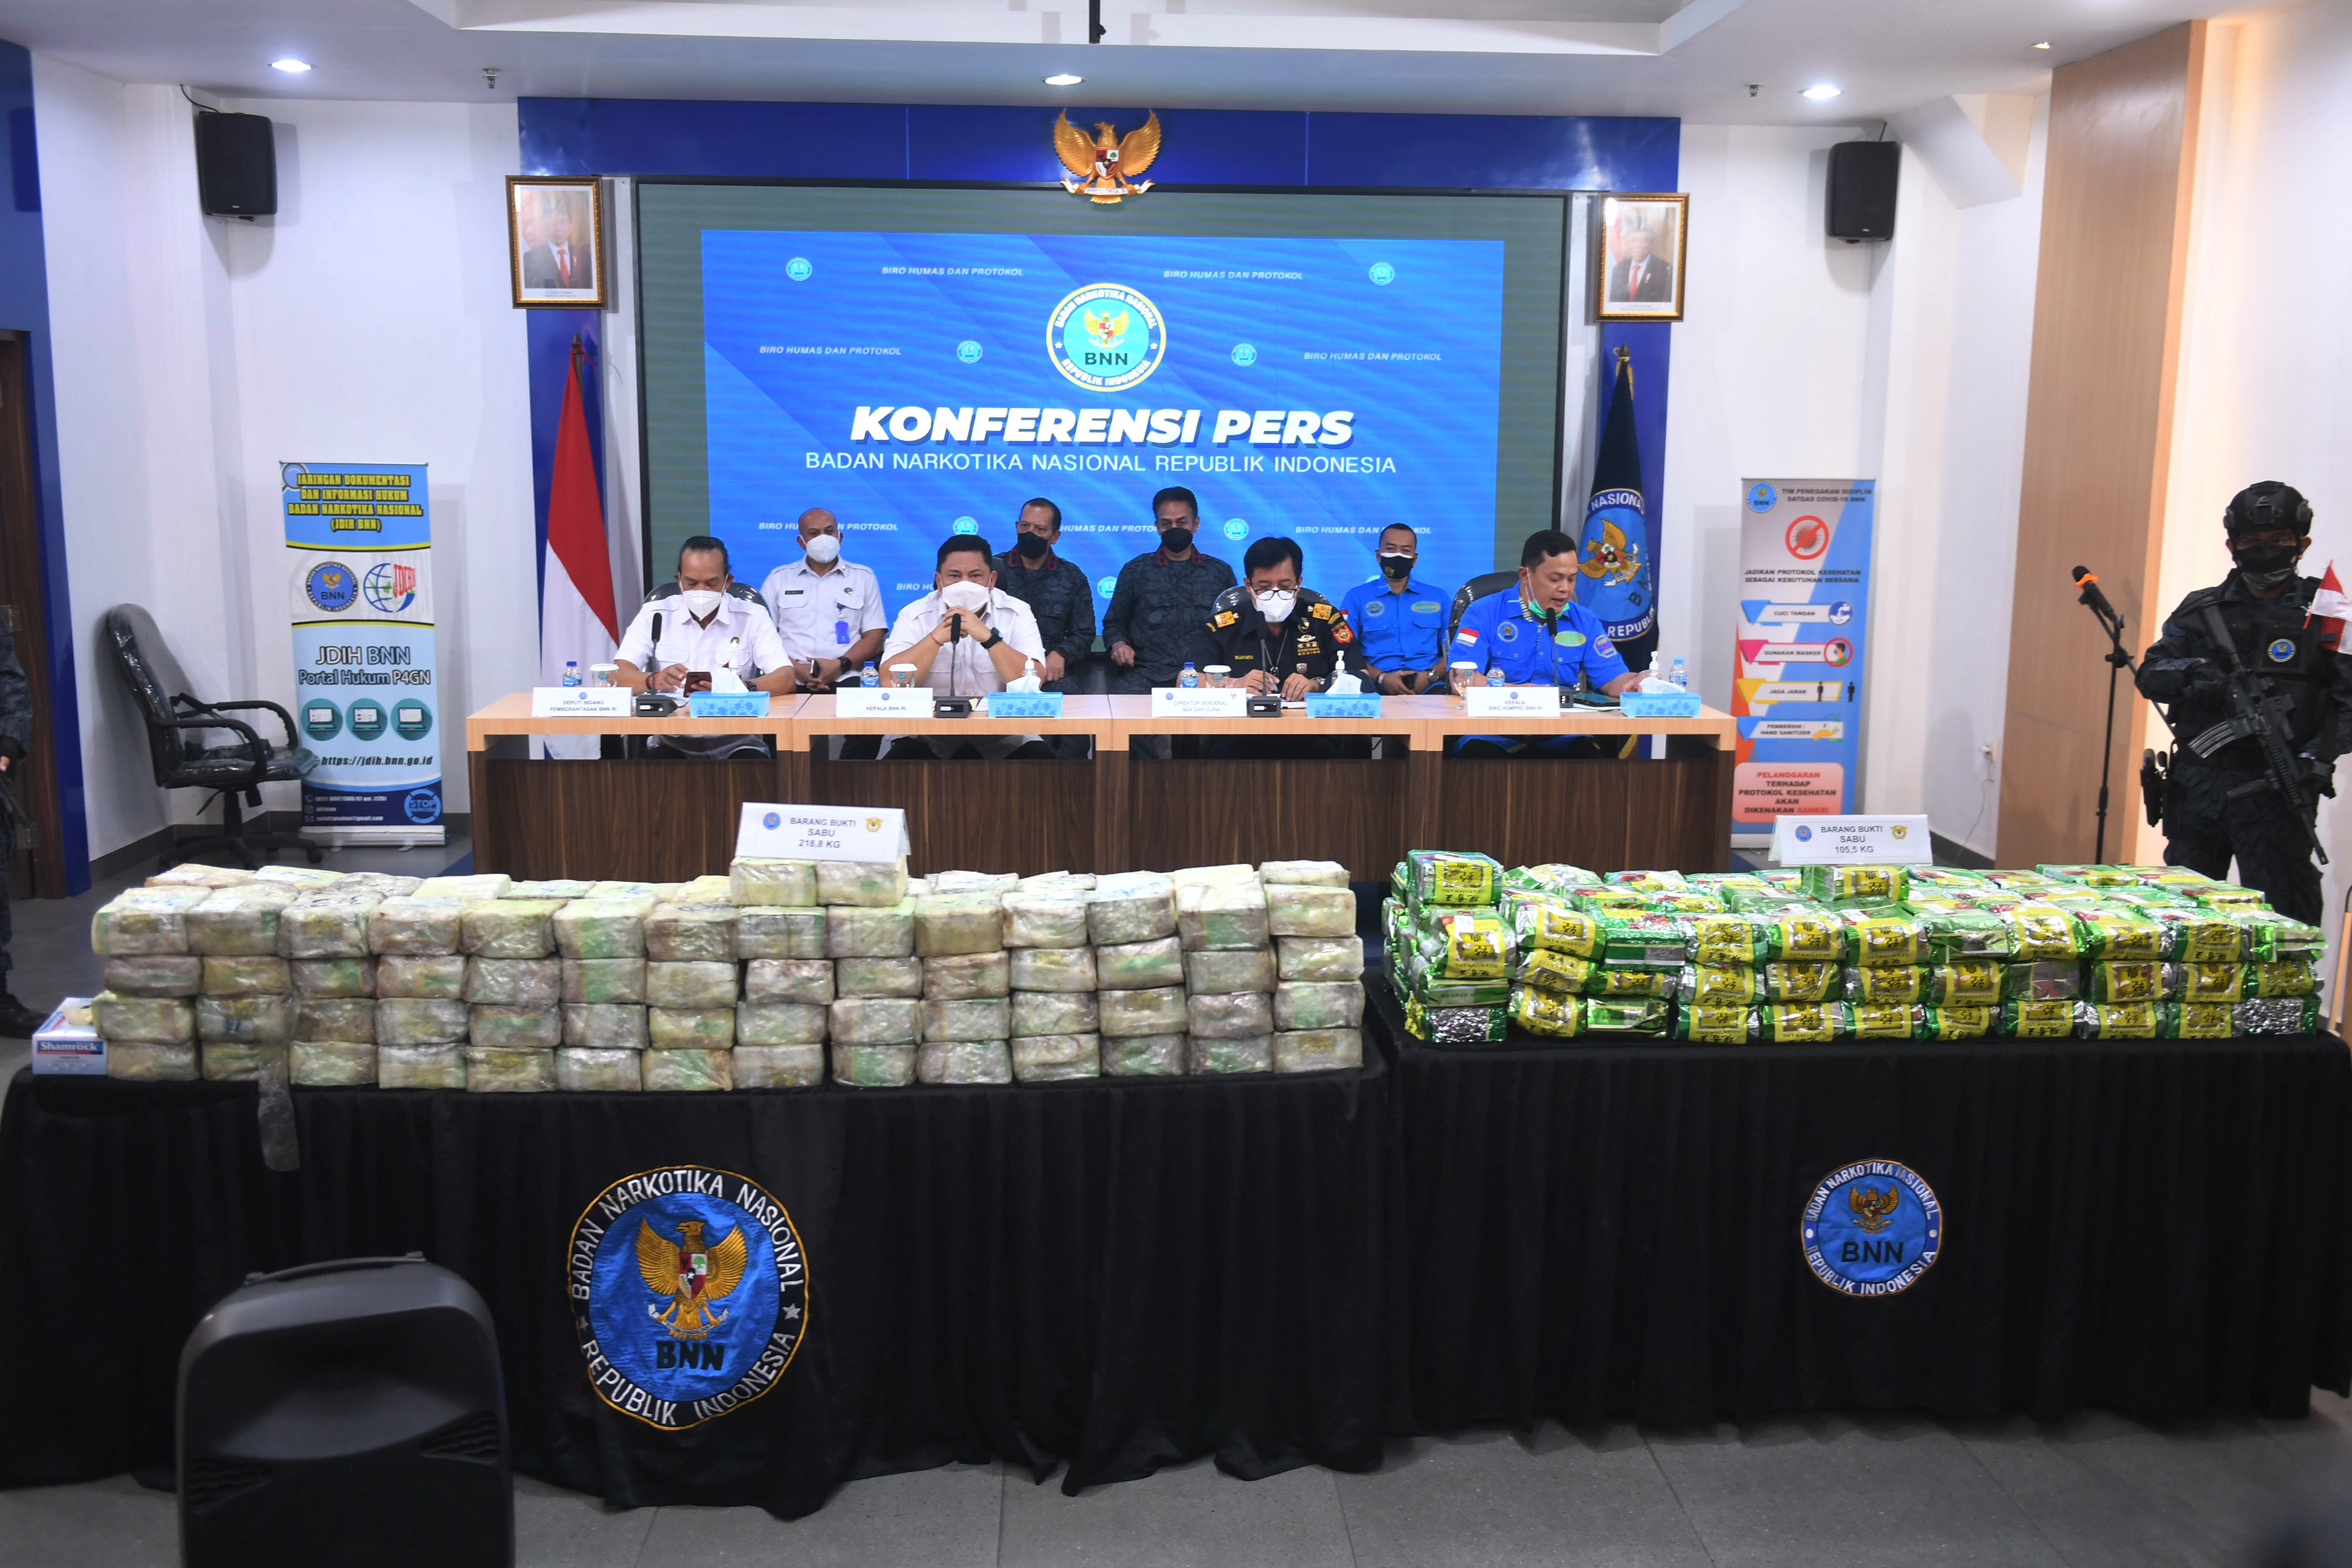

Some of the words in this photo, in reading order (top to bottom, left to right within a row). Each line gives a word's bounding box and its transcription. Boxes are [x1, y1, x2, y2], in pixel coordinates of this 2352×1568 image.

[881, 267, 906, 275] BIRO
[908, 267, 944, 275] HUMAS
[947, 268, 969, 276] DAN
[971, 268, 1024, 276] PROTOKOL
[1163, 270, 1188, 279] BIRO
[1252, 271, 1304, 279] PROTOKOL
[1054, 302, 1077, 328] BADAN
[1074, 289, 1125, 305] NARKOTIKA
[1124, 294, 1158, 329] NASIONAL
[760, 346, 784, 355] BIRO
[786, 346, 823, 355] HUMAS
[850, 347, 902, 356] PROTOKOL
[1329, 352, 1365, 360] HUMAS
[1391, 353, 1442, 361] PROTOKOL
[1085, 353, 1128, 365] BNN
[1061, 358, 1102, 385] REPUBLIK
[1105, 360, 1151, 386] INDONESIA
[850, 406, 1201, 447] KONFERENSI
[1212, 410, 1355, 449] PERS
[806, 452, 884, 469] BADAN
[893, 453, 1023, 470] NARKOTIKA
[1031, 454, 1145, 472] NASIONAL
[1155, 455, 1264, 472] REPUBLIK
[1274, 456, 1396, 473] INDONESIA
[296, 474, 342, 486] JARINGAN
[343, 474, 411, 487] DOKUMENTASI
[300, 489, 320, 500] DAN
[322, 489, 373, 501] INFORMASI
[375, 490, 409, 502] HUKUM
[288, 504, 319, 515] BADAN
[321, 504, 375, 516] NARKOTIKA
[377, 504, 423, 516] NASIONAL
[330, 519, 356, 532] (JDIH
[357, 519, 382, 533] BNN)
[1060, 524, 1095, 533] HUMAS
[1295, 526, 1319, 534] BIRO
[1321, 526, 1357, 534] HUMAS
[321, 591, 345, 600] BNN
[315, 646, 362, 665] JDIH
[366, 647, 411, 665] BNN
[298, 669, 339, 685] Portal
[340, 670, 390, 685] Hukum
[393, 670, 430, 685] P4GN
[321, 755, 433, 767] https://jdih.bnn.go.id
[790, 818, 827, 826] BARANG
[799, 840, 823, 848] 218,8
[41, 1042, 97, 1050] Shamrock
[1805, 1187, 1830, 1222] BADAN
[1826, 1162, 1892, 1189] NARKOTIKA
[572, 1218, 606, 1300] BADAN
[598, 1169, 724, 1221] NARKOTIKA
[736, 1183, 804, 1293] NASIONAL
[1840, 1241, 1904, 1263] BNN
[1807, 1245, 1856, 1293] REPUBLIK
[1860, 1251, 1936, 1295] INDONESIA
[656, 1340, 726, 1372] BNN
[583, 1338, 677, 1425] REPUBLIK
[693, 1331, 796, 1420] INDONESIA
